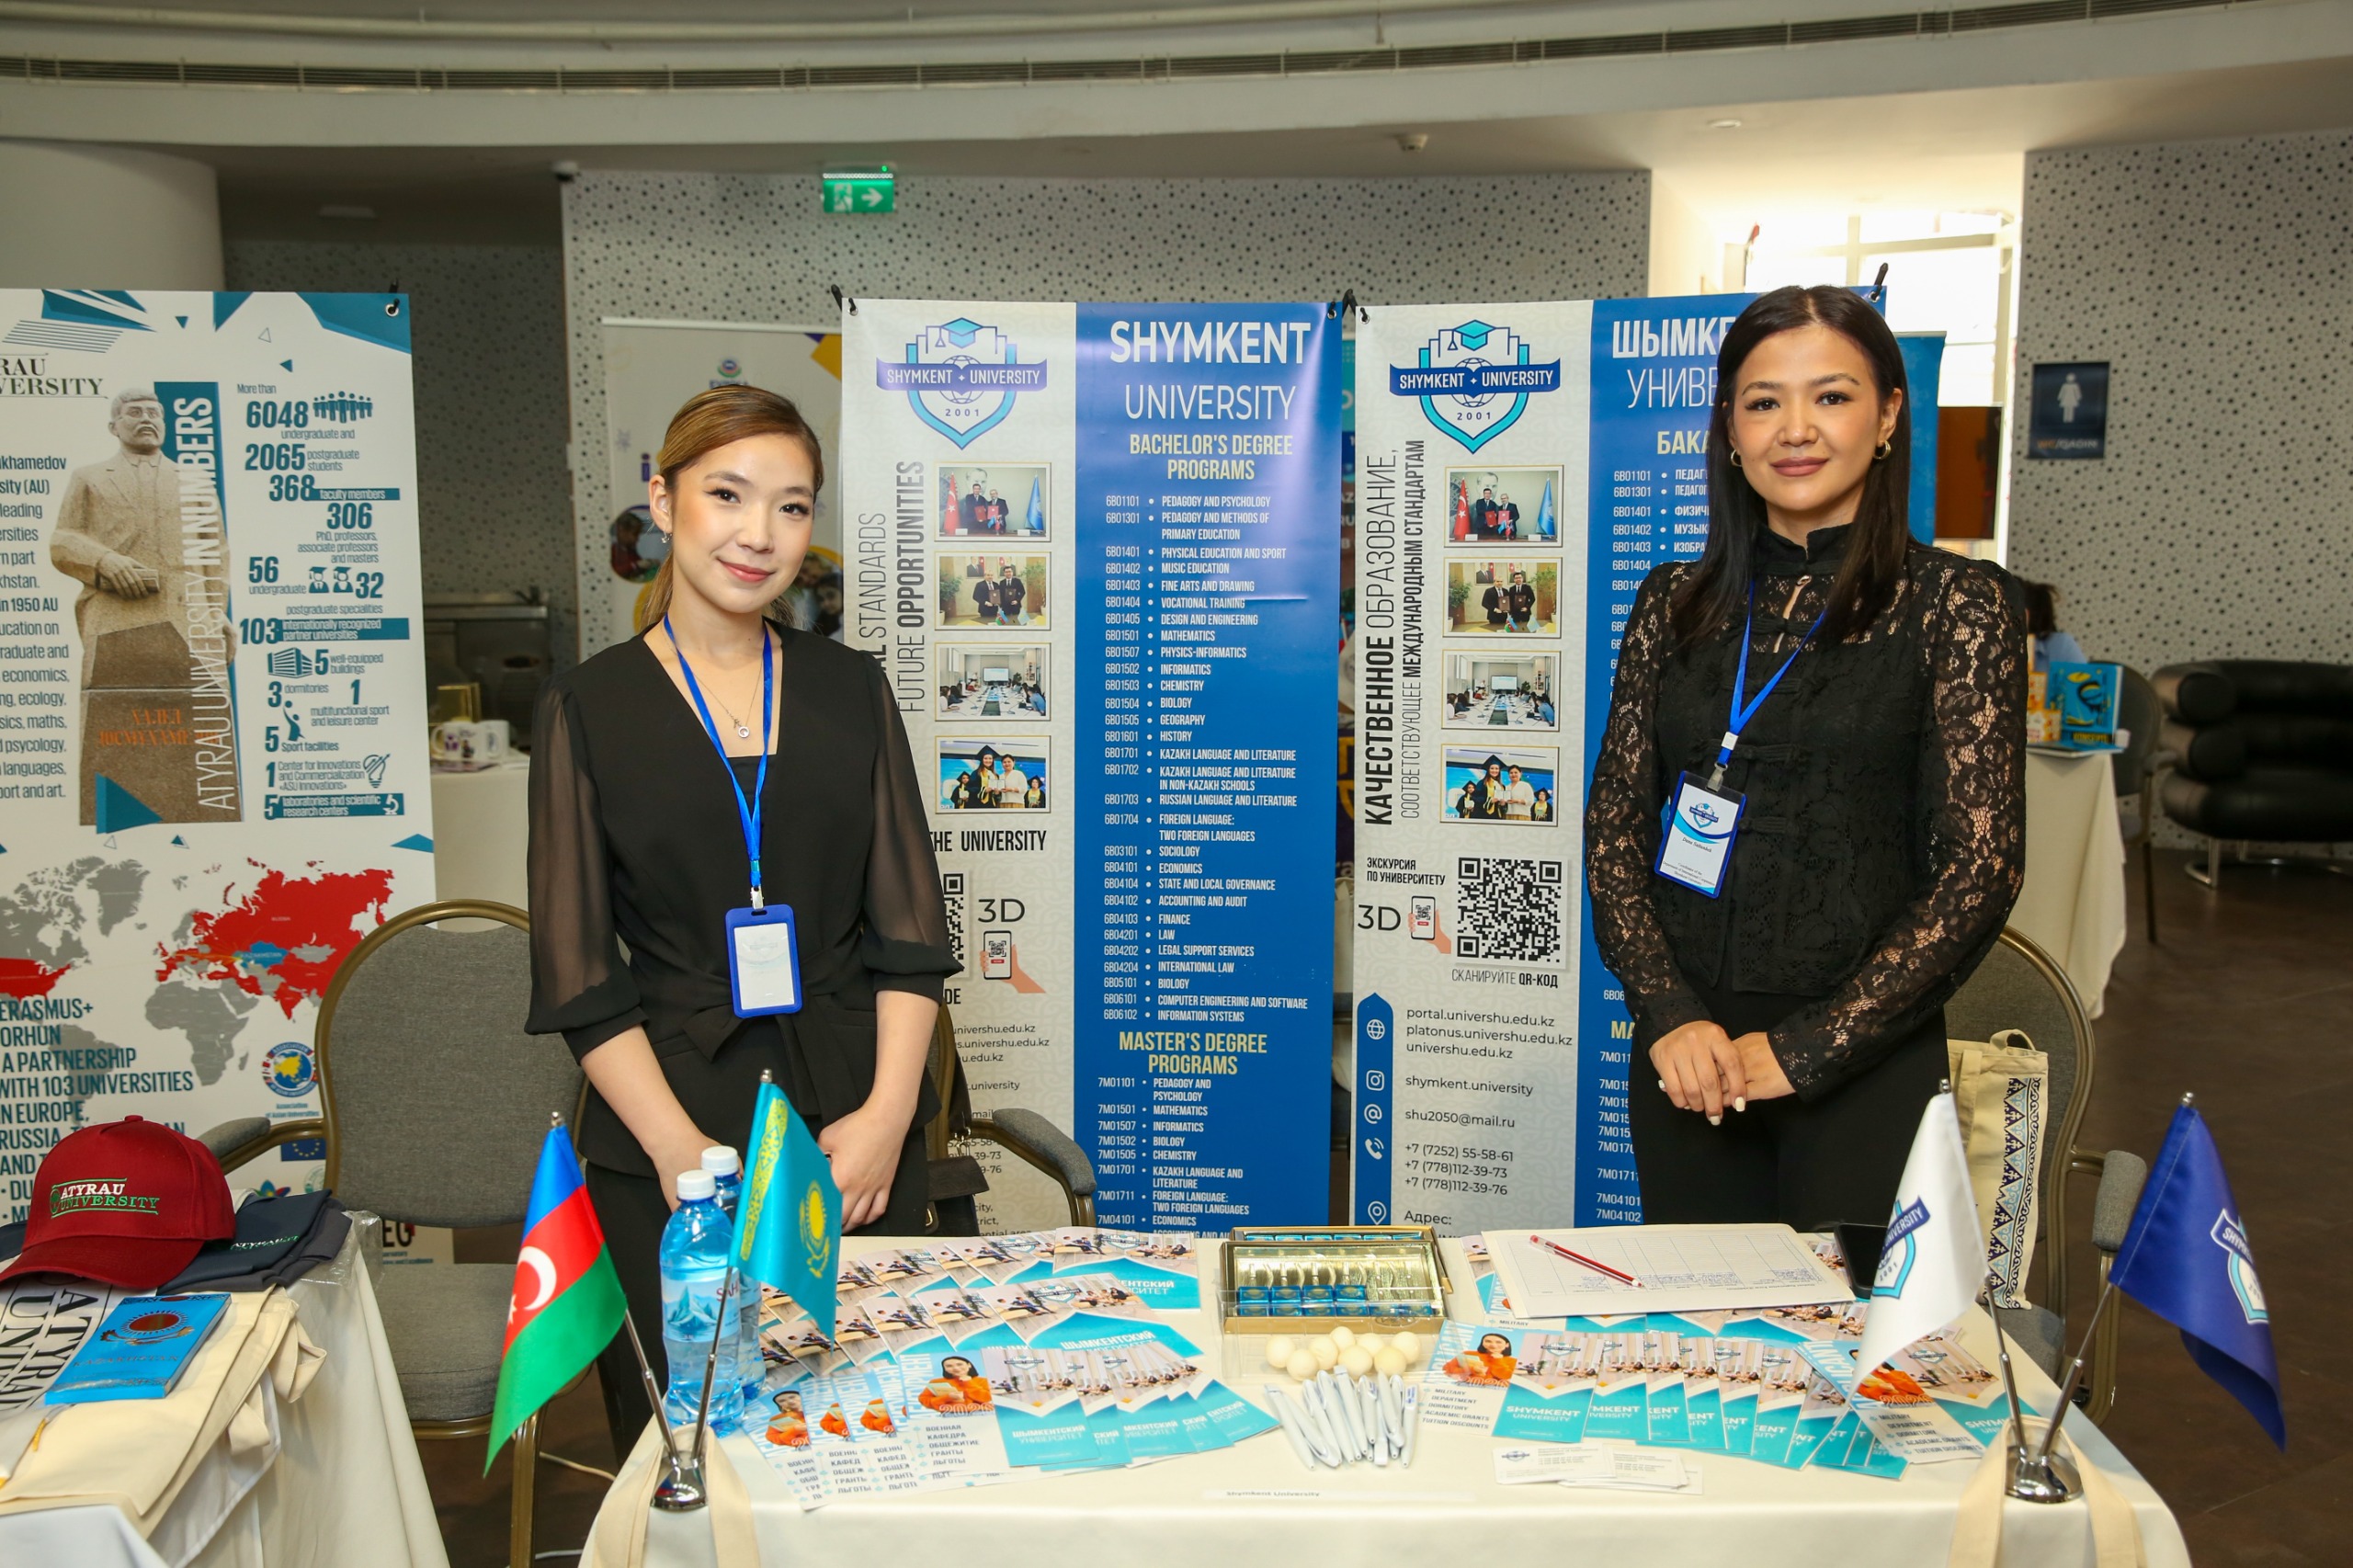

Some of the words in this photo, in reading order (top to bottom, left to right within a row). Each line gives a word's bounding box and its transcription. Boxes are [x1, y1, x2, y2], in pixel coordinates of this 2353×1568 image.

[1109, 321, 1311, 363] SHYMKENT
[887, 369, 952, 384] SHYMKENT
[970, 370, 1040, 384] UNIVERSITY
[1400, 373, 1465, 389] SHYMKENT
[1482, 370, 1553, 387] UNIVERSITY
[237, 384, 257, 393] More
[258, 384, 276, 393] than
[1125, 384, 1296, 419] UNIVERSITY
[246, 401, 308, 427] 6048
[945, 408, 979, 416] 2001
[1457, 412, 1491, 420] 2001
[281, 429, 339, 440] undergraduate
[340, 429, 355, 438] and
[1130, 434, 1227, 454] BACHELOR'S
[1232, 435, 1293, 455] DEGREE
[174, 397, 219, 534] NUMBERS
[245, 444, 305, 471] 2065
[308, 450, 359, 460] postgraduate
[308, 462, 343, 471] students
[1167, 460, 1255, 480] PROGRAMS
[1614, 471, 1651, 482] 6B01101
[24, 479, 50, 495] (AU)
[269, 475, 314, 501] 368
[320, 490, 347, 500] faculty
[348, 490, 385, 499] members
[1404, 440, 1424, 537] СТАНДАРТАМ
[1106, 495, 1139, 506] 6B01101
[1162, 496, 1201, 507] PEDAGOGY
[1203, 496, 1220, 506] AND
[1222, 496, 1270, 507] PSYCHOLOGY
[327, 503, 372, 528] 306
[1106, 513, 1140, 524] 6B01301
[1162, 513, 1201, 523] PEDAGOGY
[1203, 513, 1220, 523] AND
[1222, 513, 1257, 523] METHODS
[1259, 513, 1269, 523] OF
[1162, 529, 1196, 540] PRIMARY
[1199, 529, 1240, 540] EDUCATION
[1366, 449, 1400, 629] ОБРАЗОВАНИЕ,
[182, 539, 221, 565] IN
[896, 461, 925, 627] OPPORTUNITIES
[12, 551, 35, 566] part
[249, 557, 278, 583] 56
[858, 513, 886, 638] STANDARDS
[1106, 563, 1140, 574] 6B01402
[1162, 563, 1186, 574] MUSIC
[1188, 563, 1229, 574] EDUCATION
[356, 572, 383, 598] 32
[1106, 580, 1140, 591] 6B01403
[1162, 581, 1178, 591] FINE
[1180, 581, 1199, 591] ARTS
[1201, 581, 1218, 591] AND
[1220, 581, 1255, 592] DRAWING
[11, 597, 40, 611] 1950
[42, 597, 58, 611] AU
[287, 605, 338, 615] postgraduate
[1402, 540, 1423, 677] МЕЖДУНАРОДНЫМ
[240, 618, 278, 644] 103
[338, 619, 381, 630] recognized
[1106, 631, 1139, 641] 6B01501
[1161, 631, 1215, 642] MATHEMATICS
[185, 571, 230, 710] UNIVERSITY
[1106, 647, 1139, 657] 6B01507
[1161, 647, 1246, 658] PHYSICS-INFORMATICS
[897, 634, 925, 711] FUTURE
[1106, 664, 1139, 674] 6B01502
[1161, 665, 1211, 675] INFORMATICS
[285, 684, 328, 693] dormitories
[1105, 680, 1139, 690] 6B01503
[1161, 680, 1204, 691] CHEMISTRY
[1105, 715, 1139, 725] 6B01505
[1160, 715, 1205, 725] GEOGRAPHY
[1364, 635, 1394, 825] КАЧЕСТВЕННОЕ
[281, 742, 303, 753] Sport
[305, 742, 338, 751] facilities
[1401, 681, 1423, 818] СООТВЕТСТВУЮЩЕЕ
[193, 718, 236, 811] ATYRAU
[1105, 794, 1138, 804] 6B01703
[1160, 795, 1192, 805] RUSSIAN
[1194, 795, 1233, 806] LANGUAGE
[1235, 796, 1251, 806] AND
[1253, 796, 1297, 806] LITERATURE
[961, 830, 1046, 851] UNIVERSITY
[1105, 846, 1138, 857] 6B03101
[1159, 846, 1200, 857] SOCIOLOGY
[1105, 862, 1138, 872] 6B04101
[1159, 863, 1202, 873] ECONOMICS
[1367, 858, 1415, 870] ЭКСКУРСИЯ
[1367, 871, 1378, 881] ПО
[1380, 871, 1445, 885] УНИВЕРСИТЕТУ
[978, 899, 1025, 923] 3D
[1357, 904, 1401, 930] 3D
[1104, 929, 1138, 940] 6B04201
[1159, 930, 1175, 940] LAW
[1104, 962, 1138, 972] 6B04204
[1158, 961, 1216, 972] INTERNATIONAL
[1218, 963, 1234, 972] LAW
[1452, 969, 1516, 985] СКАНИРУЙТЕ
[1518, 974, 1558, 989] QR-КОД
[1407, 1008, 1555, 1028] portal.univershu.edu.kz
[1, 1025, 62, 1047] ORHUN
[1120, 1031, 1201, 1051] MASTER'S
[1205, 1033, 1267, 1053] DEGREE
[1406, 1025, 1572, 1046] platonus.univershu.edu.kz
[1406, 1042, 1513, 1059] univershu.edu.kz
[3, 1052, 14, 1073] A
[18, 1048, 136, 1072] PARTNERSHIP
[1149, 1055, 1238, 1074] PROGRAMS
[42, 1076, 74, 1096] 103
[78, 1071, 193, 1096] UNIVERSITIES
[1405, 1075, 1533, 1096] shymkent.university
[17, 1101, 89, 1123] EUROPE,
[1098, 1105, 1135, 1115] 7M01501
[1154, 1106, 1208, 1116] MATHEMATICS
[1405, 1109, 1515, 1128] shu2050@mail.ru
[1405, 1143, 1418, 1153] +7
[1423, 1144, 1459, 1159] (7252)
[1462, 1148, 1513, 1162] 55-58-61
[61, 1183, 125, 1199] ATYRAU
[61, 1196, 160, 1210] UNIVERSITY
[1404, 1210, 1451, 1225] Адрес:
[1597, 1209, 1641, 1222] 7M04102
[1061, 1331, 1156, 1349] ШЫМКЕНТСКИЙ
[74, 1356, 178, 1367] KAZAKHSTAN
[1428, 1403, 1468, 1411] DORMITORY
[1431, 1395, 1477, 1404] DEPARTMENT
[1425, 1410, 1461, 1418] ACADEMIC
[1462, 1414, 1489, 1422] GRANTS
[1506, 1405, 1580, 1417] SHYMKENT
[1513, 1414, 1571, 1422] UNIVERSITY
[1013, 1426, 1086, 1437] ШЫМКЕНТСКИЙ
[1450, 1420, 1489, 1429] DISCOUNTS
[929, 1439, 980, 1449] ОБЩЕЖИТИЕ
